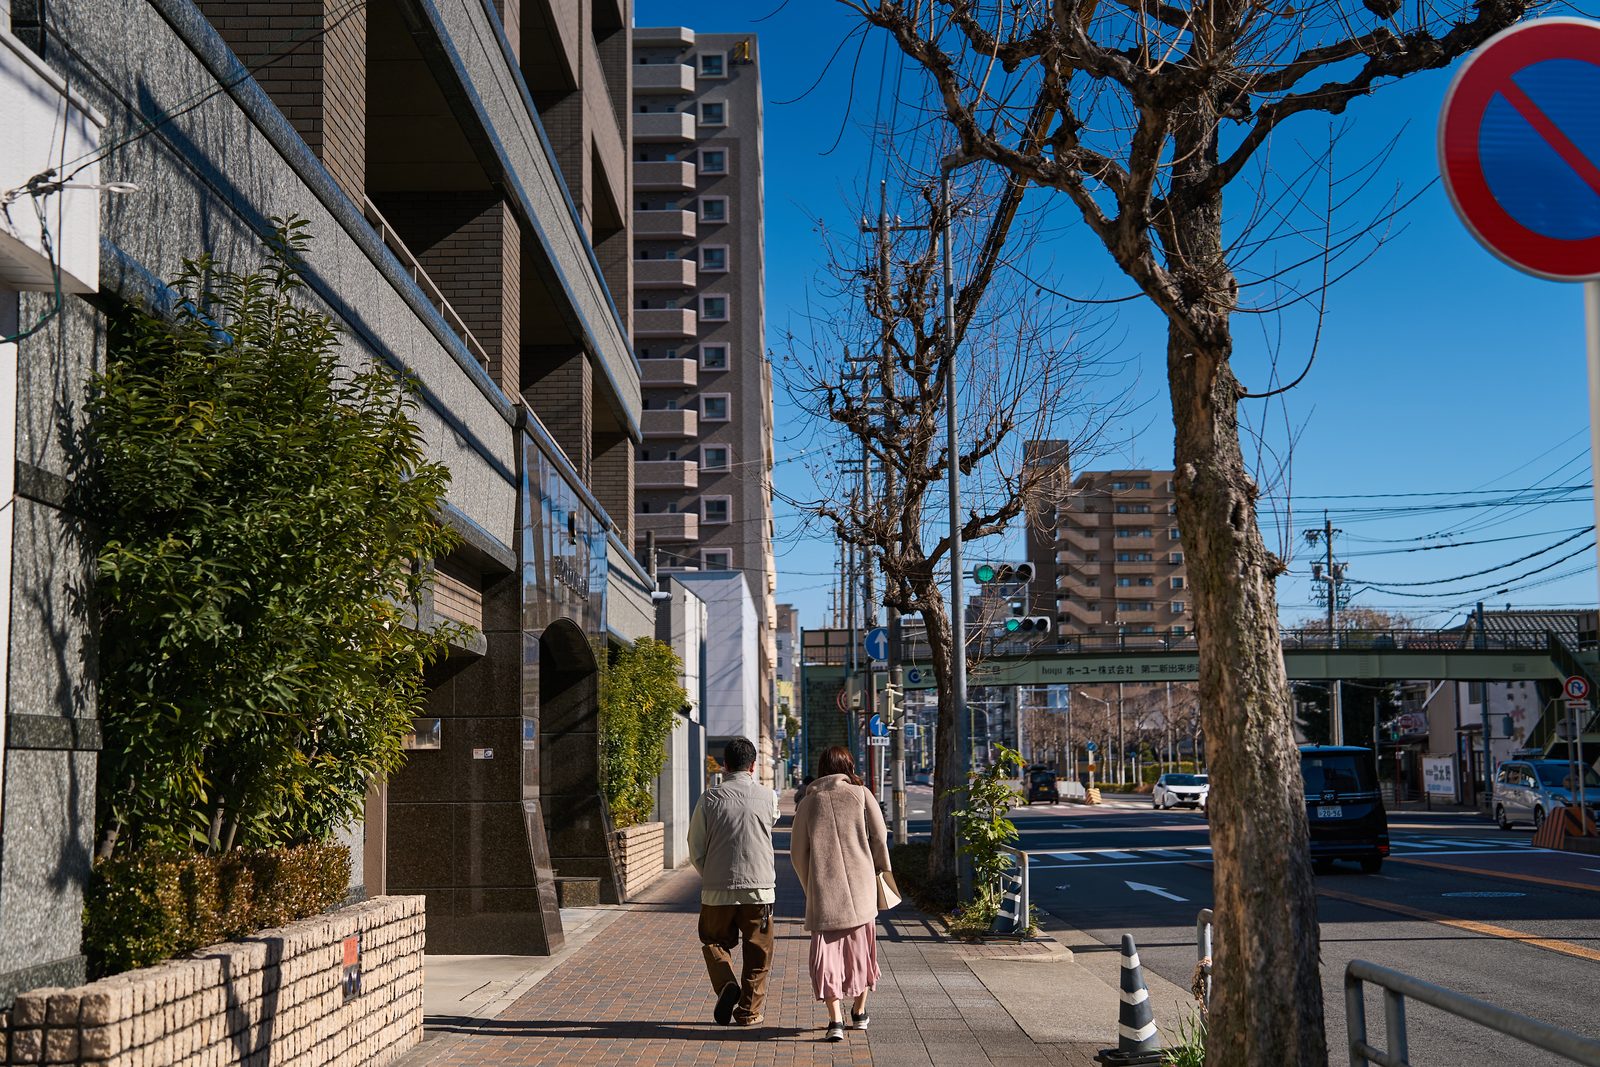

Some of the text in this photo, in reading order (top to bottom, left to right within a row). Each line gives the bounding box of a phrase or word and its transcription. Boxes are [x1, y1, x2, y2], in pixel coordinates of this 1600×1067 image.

[1067, 664, 1134, 675] ホーユー株式会社
